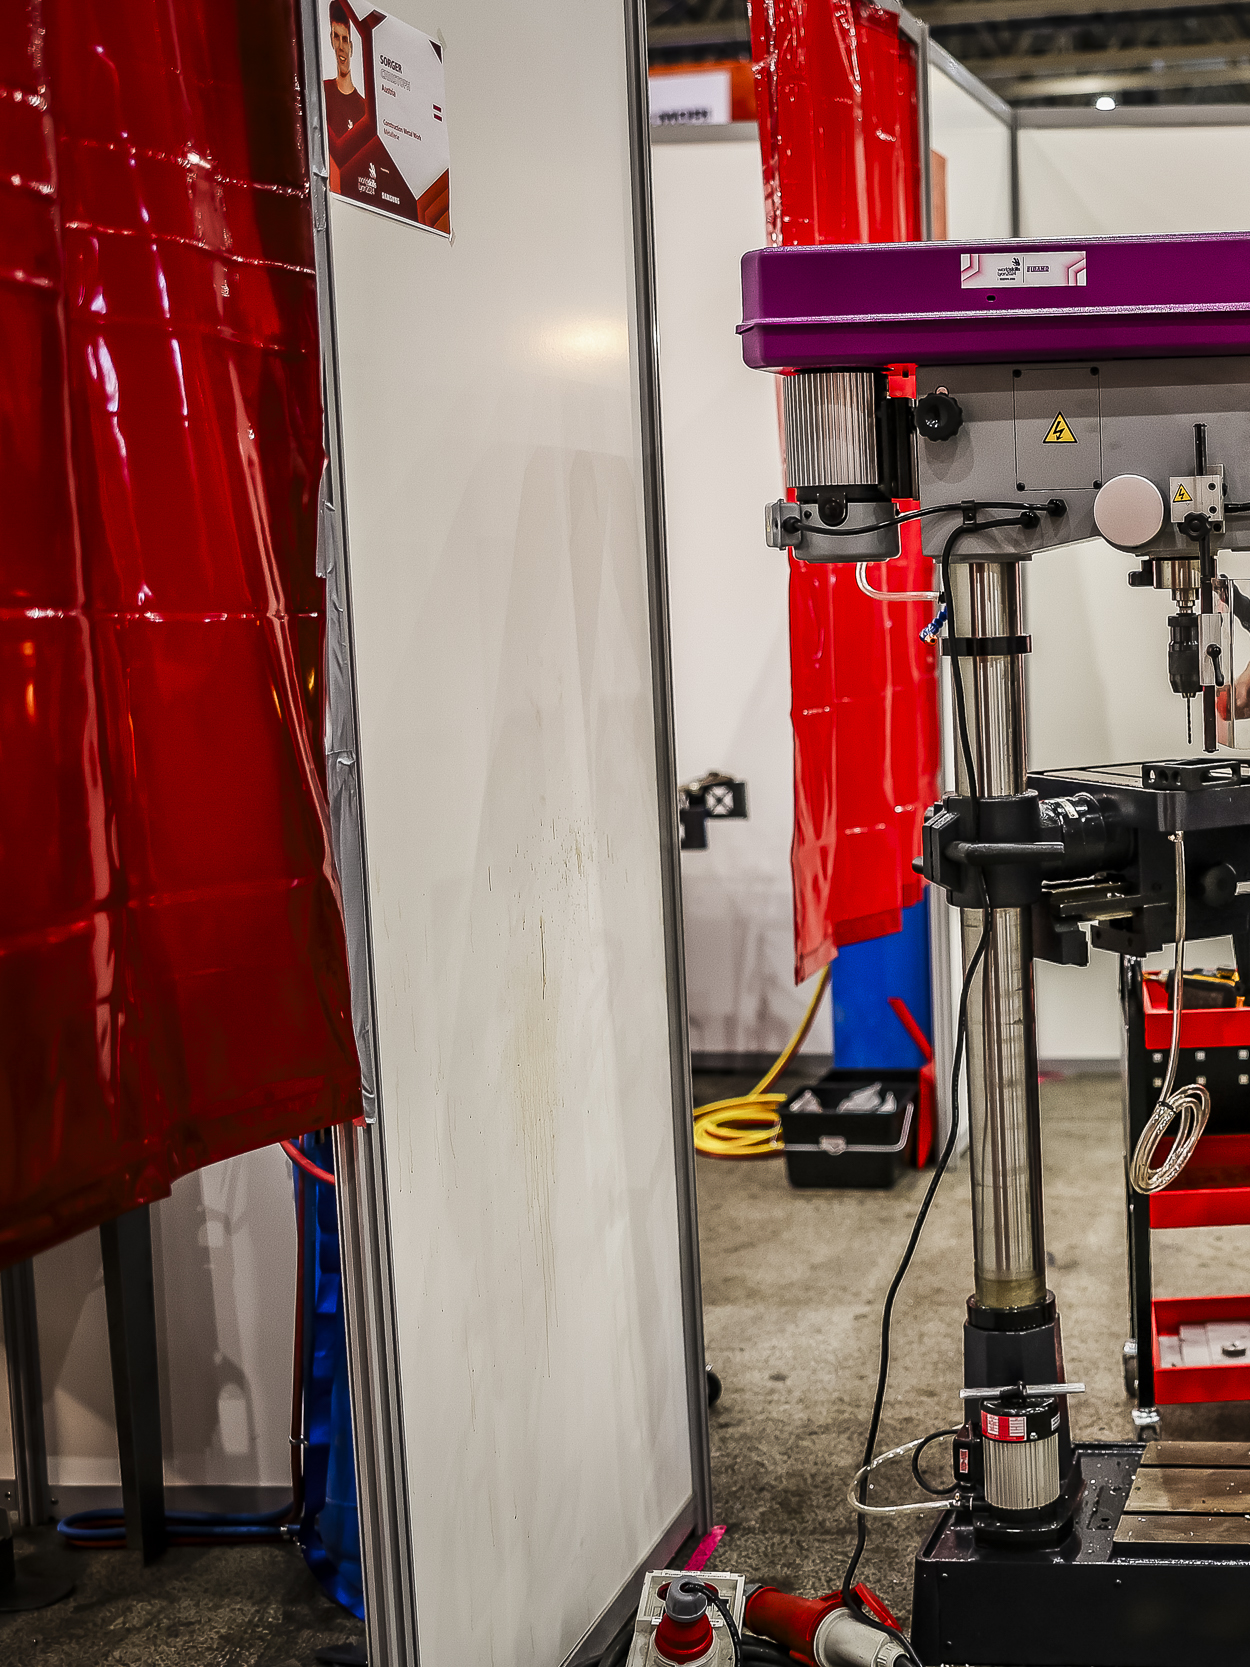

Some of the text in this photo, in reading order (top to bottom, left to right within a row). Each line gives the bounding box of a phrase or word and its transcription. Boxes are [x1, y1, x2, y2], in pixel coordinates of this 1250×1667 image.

[379, 55, 402, 74] SORGER
[381, 84, 396, 98] Austria
[383, 118, 403, 134] Construction
[381, 191, 400, 204] SAMSUNG
